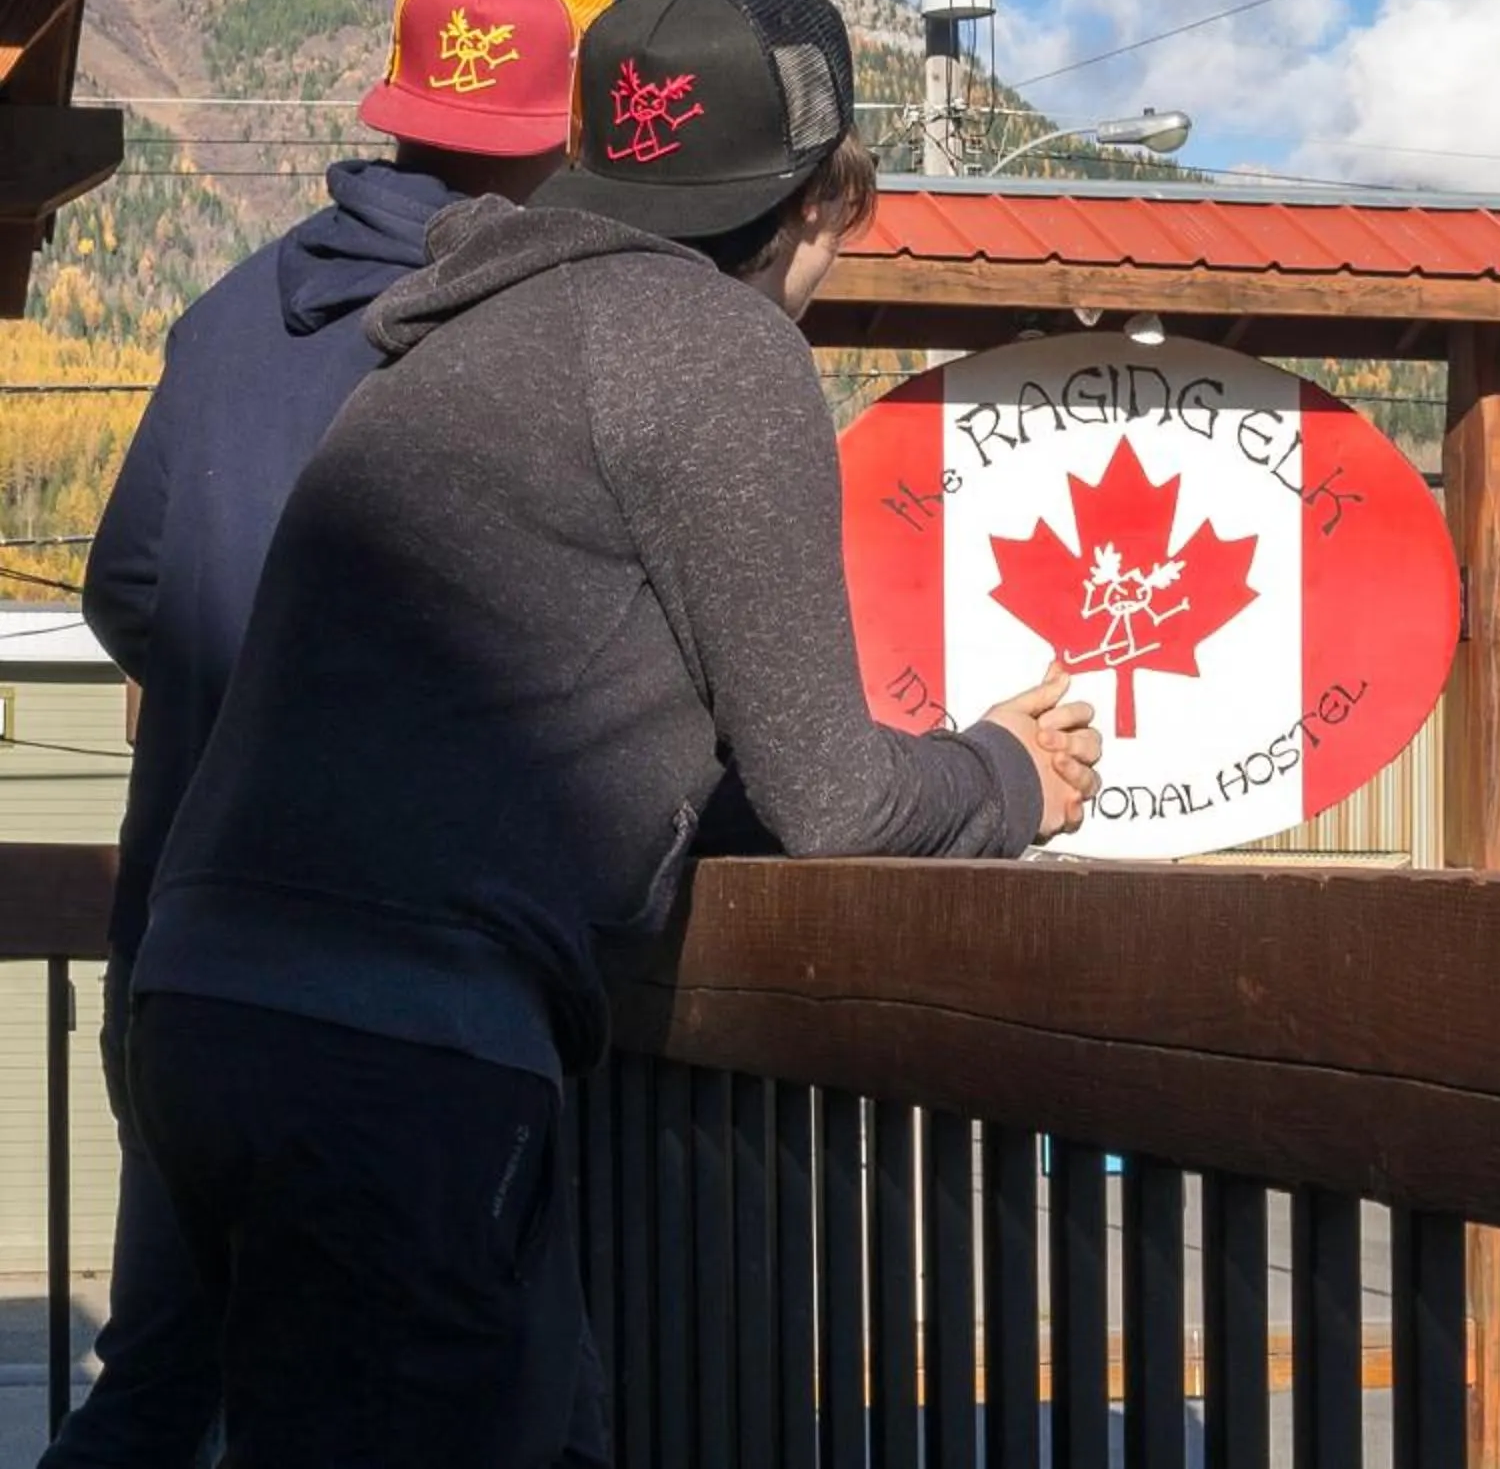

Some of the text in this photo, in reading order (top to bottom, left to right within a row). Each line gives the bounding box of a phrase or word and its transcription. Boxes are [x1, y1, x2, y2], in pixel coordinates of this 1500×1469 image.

[955, 364, 1224, 467] RAGING
[1237, 409, 1364, 536] ELK
[1215, 680, 1368, 802] HOSTEL
